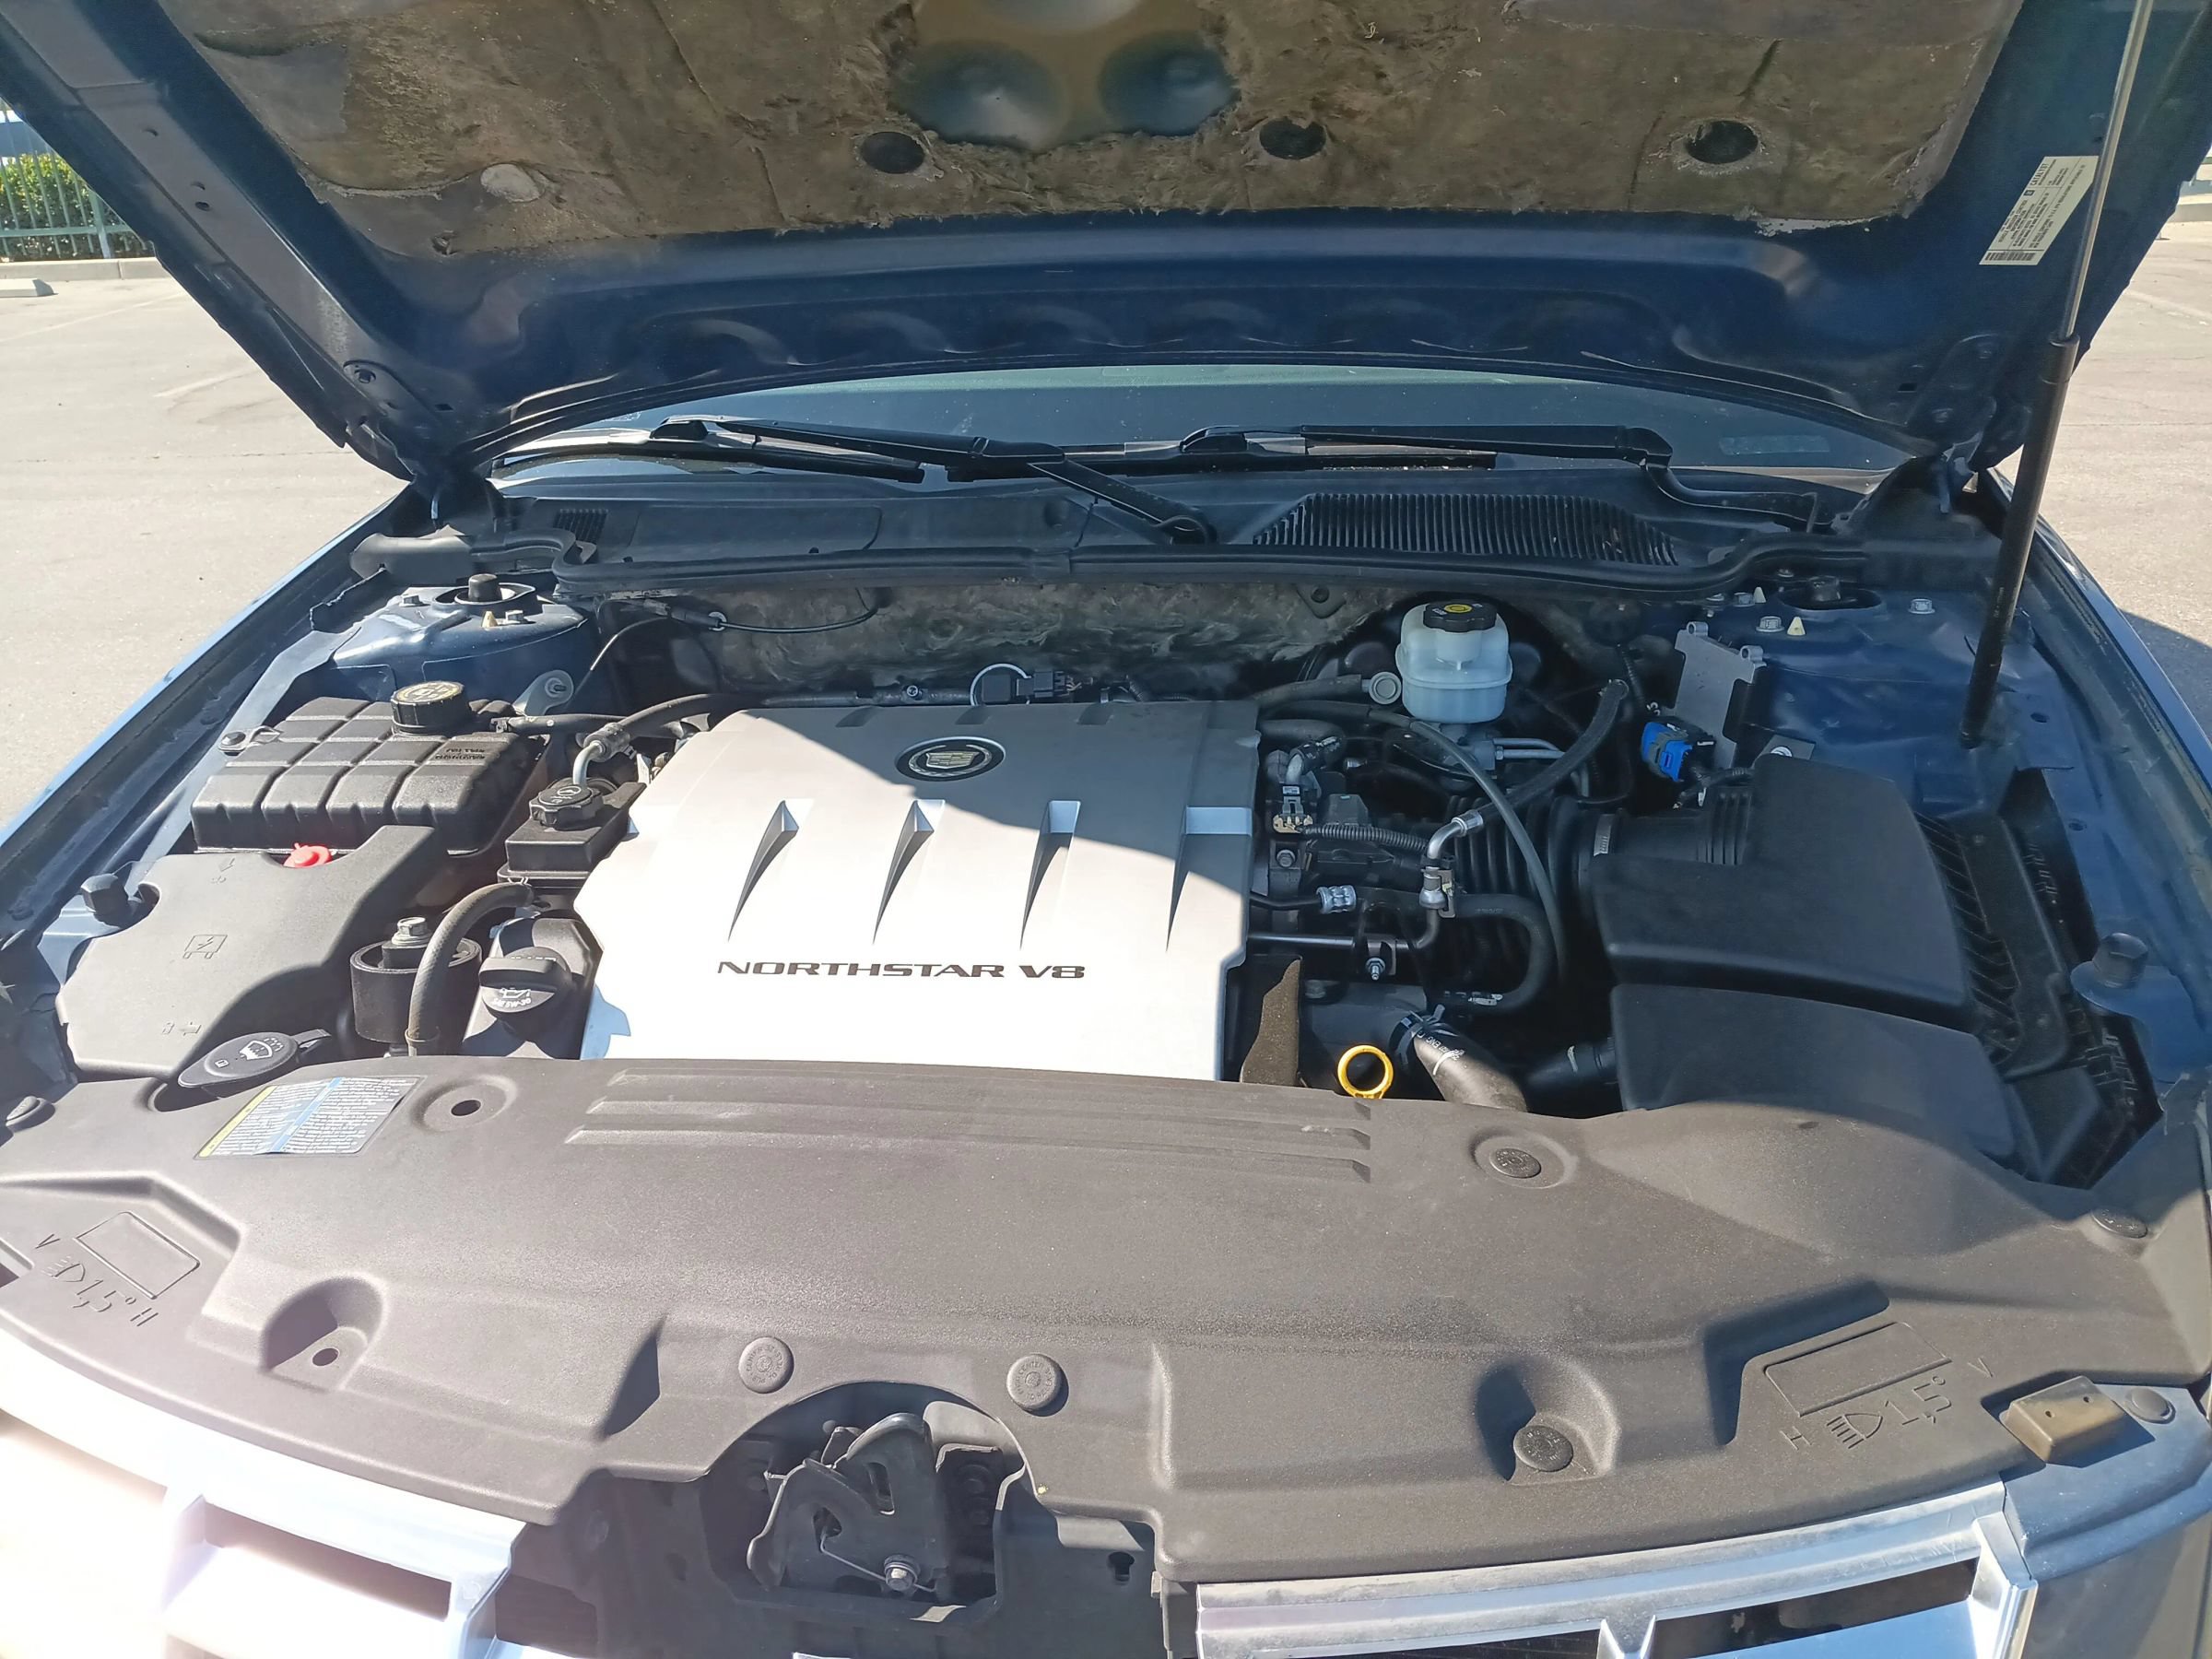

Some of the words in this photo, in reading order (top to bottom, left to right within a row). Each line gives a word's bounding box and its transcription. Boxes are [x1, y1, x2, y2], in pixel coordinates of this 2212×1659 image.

[2030, 163, 2049, 185] CATALYST
[717, 961, 1005, 978] NORTHSTAR
[1018, 964, 1086, 980] V8
[505, 997, 532, 1008] 5W-30
